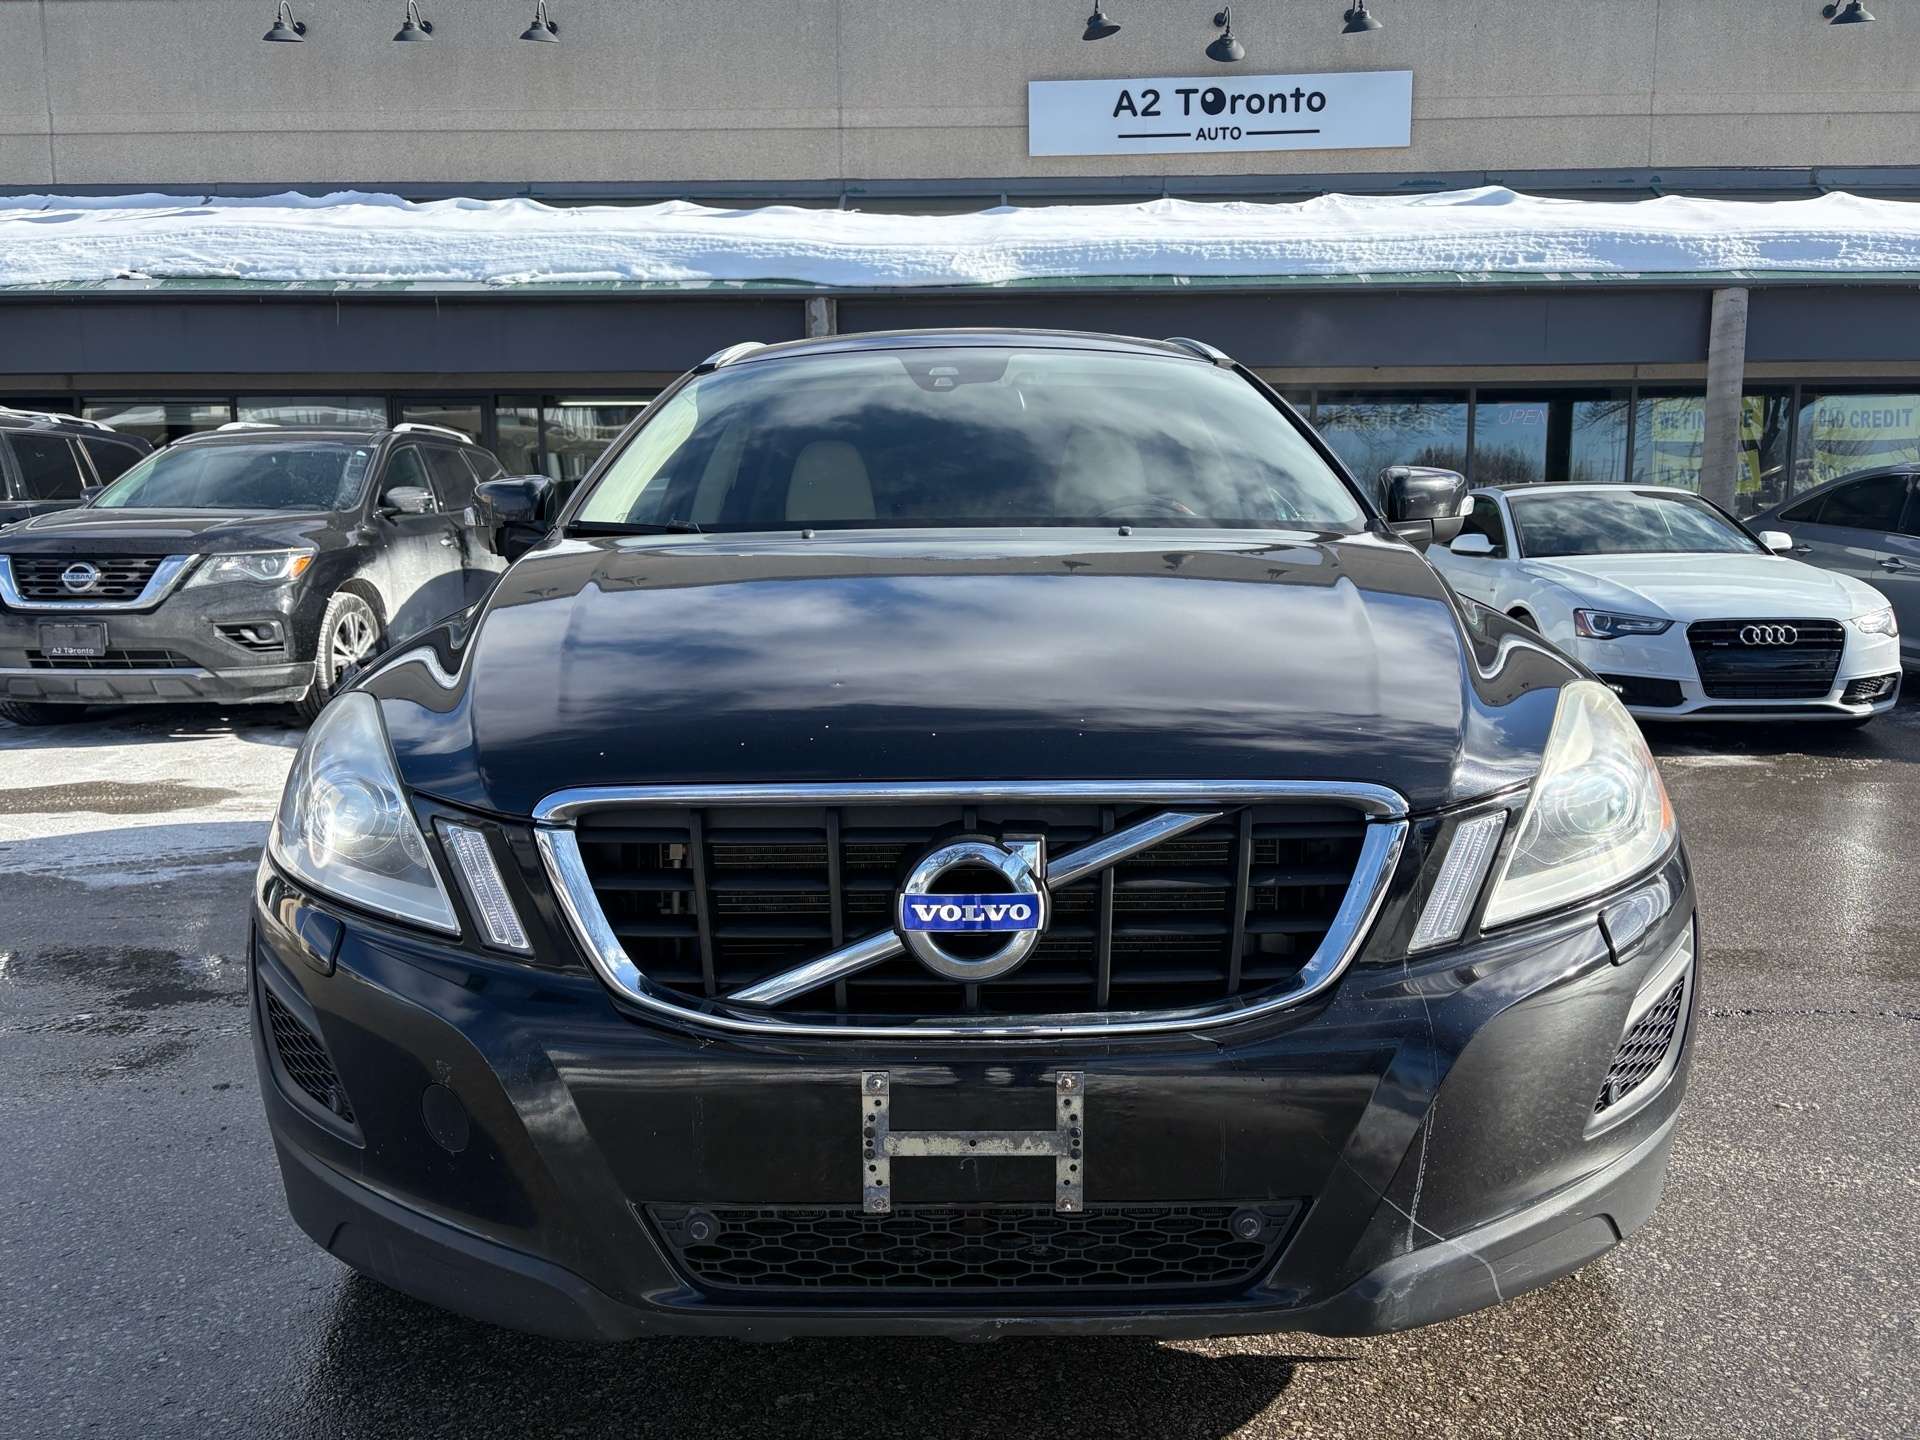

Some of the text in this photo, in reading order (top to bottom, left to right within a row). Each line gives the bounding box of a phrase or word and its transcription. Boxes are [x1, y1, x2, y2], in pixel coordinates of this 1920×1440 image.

[1113, 89, 1161, 118] A2
[1195, 126, 1242, 141] AUTO
[1850, 408, 1913, 429] CREDIT
[911, 903, 1032, 922] VOLVO
